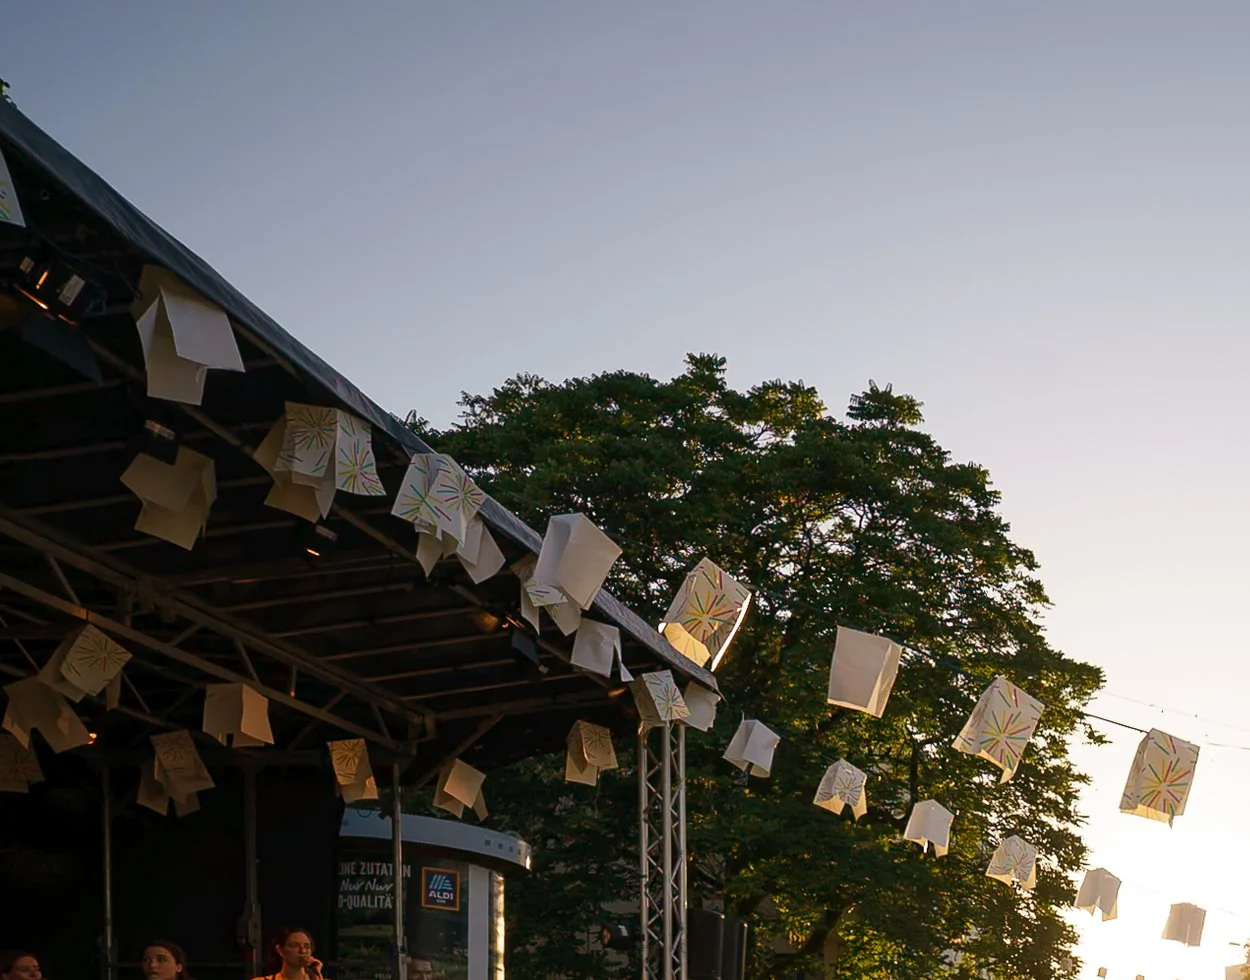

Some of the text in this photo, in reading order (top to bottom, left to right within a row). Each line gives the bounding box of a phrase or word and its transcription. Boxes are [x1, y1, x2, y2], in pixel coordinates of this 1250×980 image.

[359, 861, 412, 878] ZUTATN
[338, 893, 394, 909] O-QUALITÄ
[428, 890, 454, 900] ALDI
